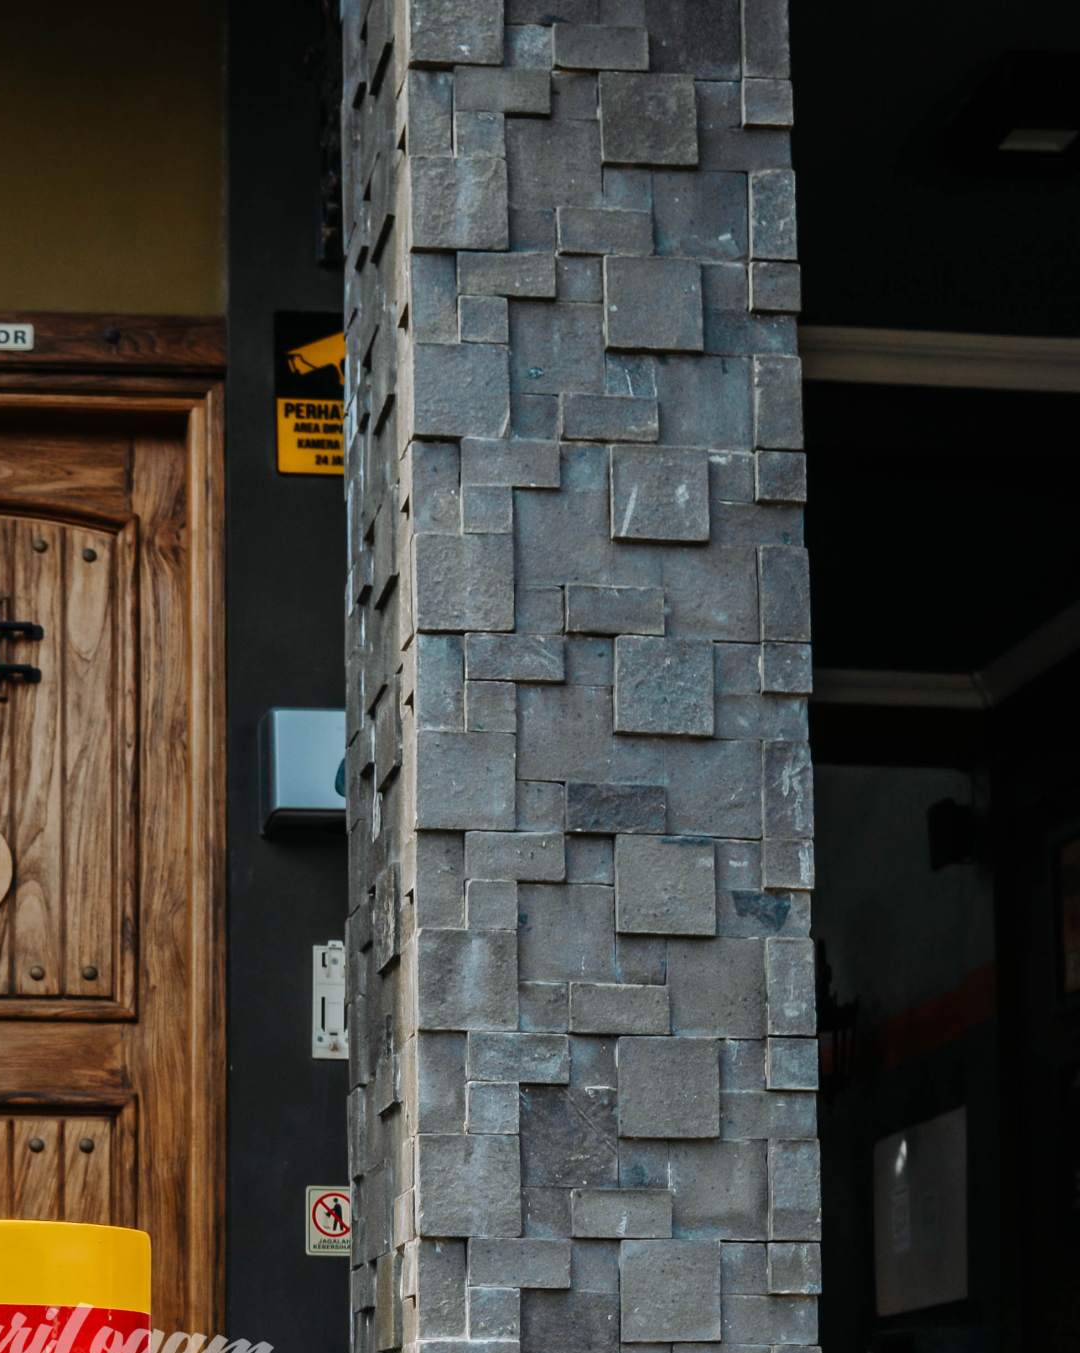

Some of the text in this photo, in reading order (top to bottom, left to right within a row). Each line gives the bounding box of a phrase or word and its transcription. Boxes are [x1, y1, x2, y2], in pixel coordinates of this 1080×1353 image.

[284, 402, 344, 420] PERHA
[293, 422, 321, 434] AREA
[297, 438, 340, 450] KAMERA
[315, 454, 329, 466] 24
